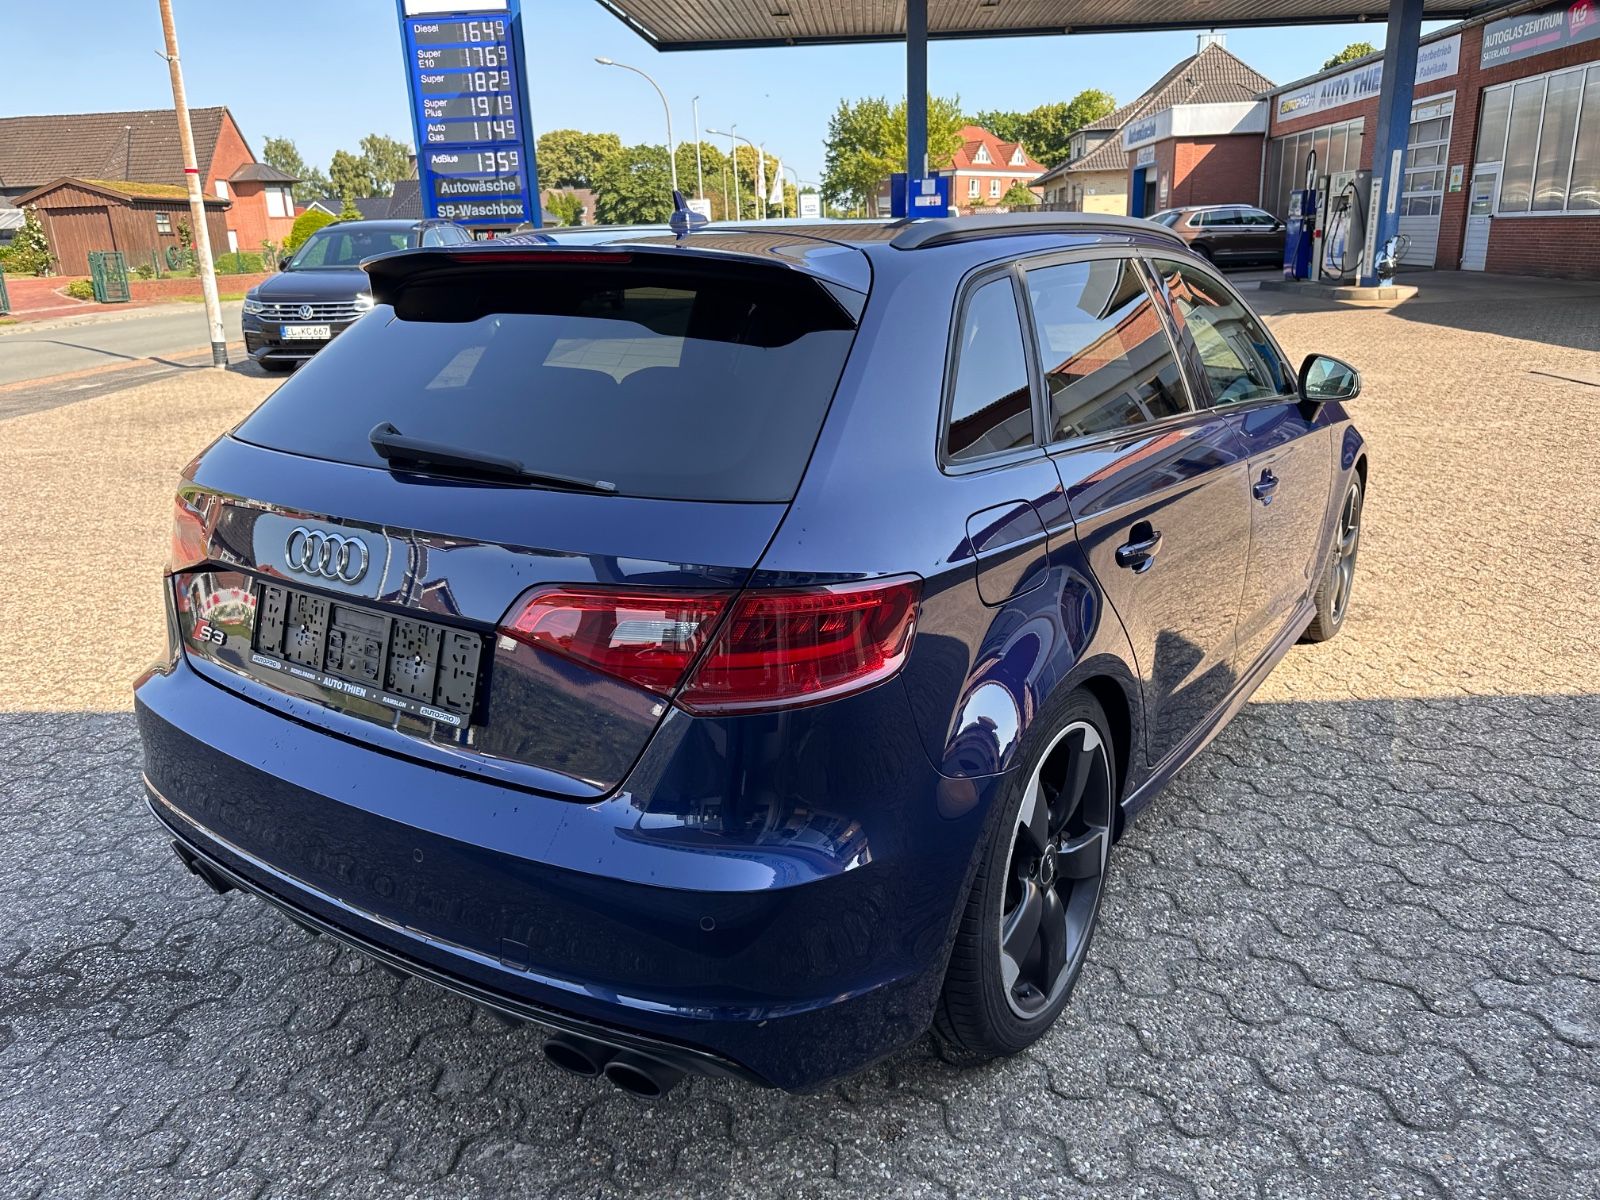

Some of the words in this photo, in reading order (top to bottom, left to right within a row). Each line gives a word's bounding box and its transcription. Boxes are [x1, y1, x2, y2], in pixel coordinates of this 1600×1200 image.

[414, 24, 439, 33] Diesel
[1485, 26, 1523, 48] AUTOGLAS
[1524, 12, 1564, 36] ZENTRUM
[417, 50, 442, 59] Super
[1483, 46, 1510, 61] SATERLAND
[418, 59, 435, 68] E10
[420, 75, 444, 83] Super
[1319, 77, 1349, 107] AUTO
[1353, 66, 1382, 97] THIE
[424, 100, 447, 109] Super
[425, 109, 442, 118] Plus
[427, 124, 446, 132] Auto
[428, 133, 445, 142] Gas
[431, 154, 458, 164] AdBlue
[441, 180, 516, 194] Autowäsche
[437, 203, 524, 218] SB-Waschbox
[313, 327, 328, 336] 667
[200, 625, 225, 645] S3
[323, 677, 343, 690] AUTO
[344, 683, 367, 698] THIEN
